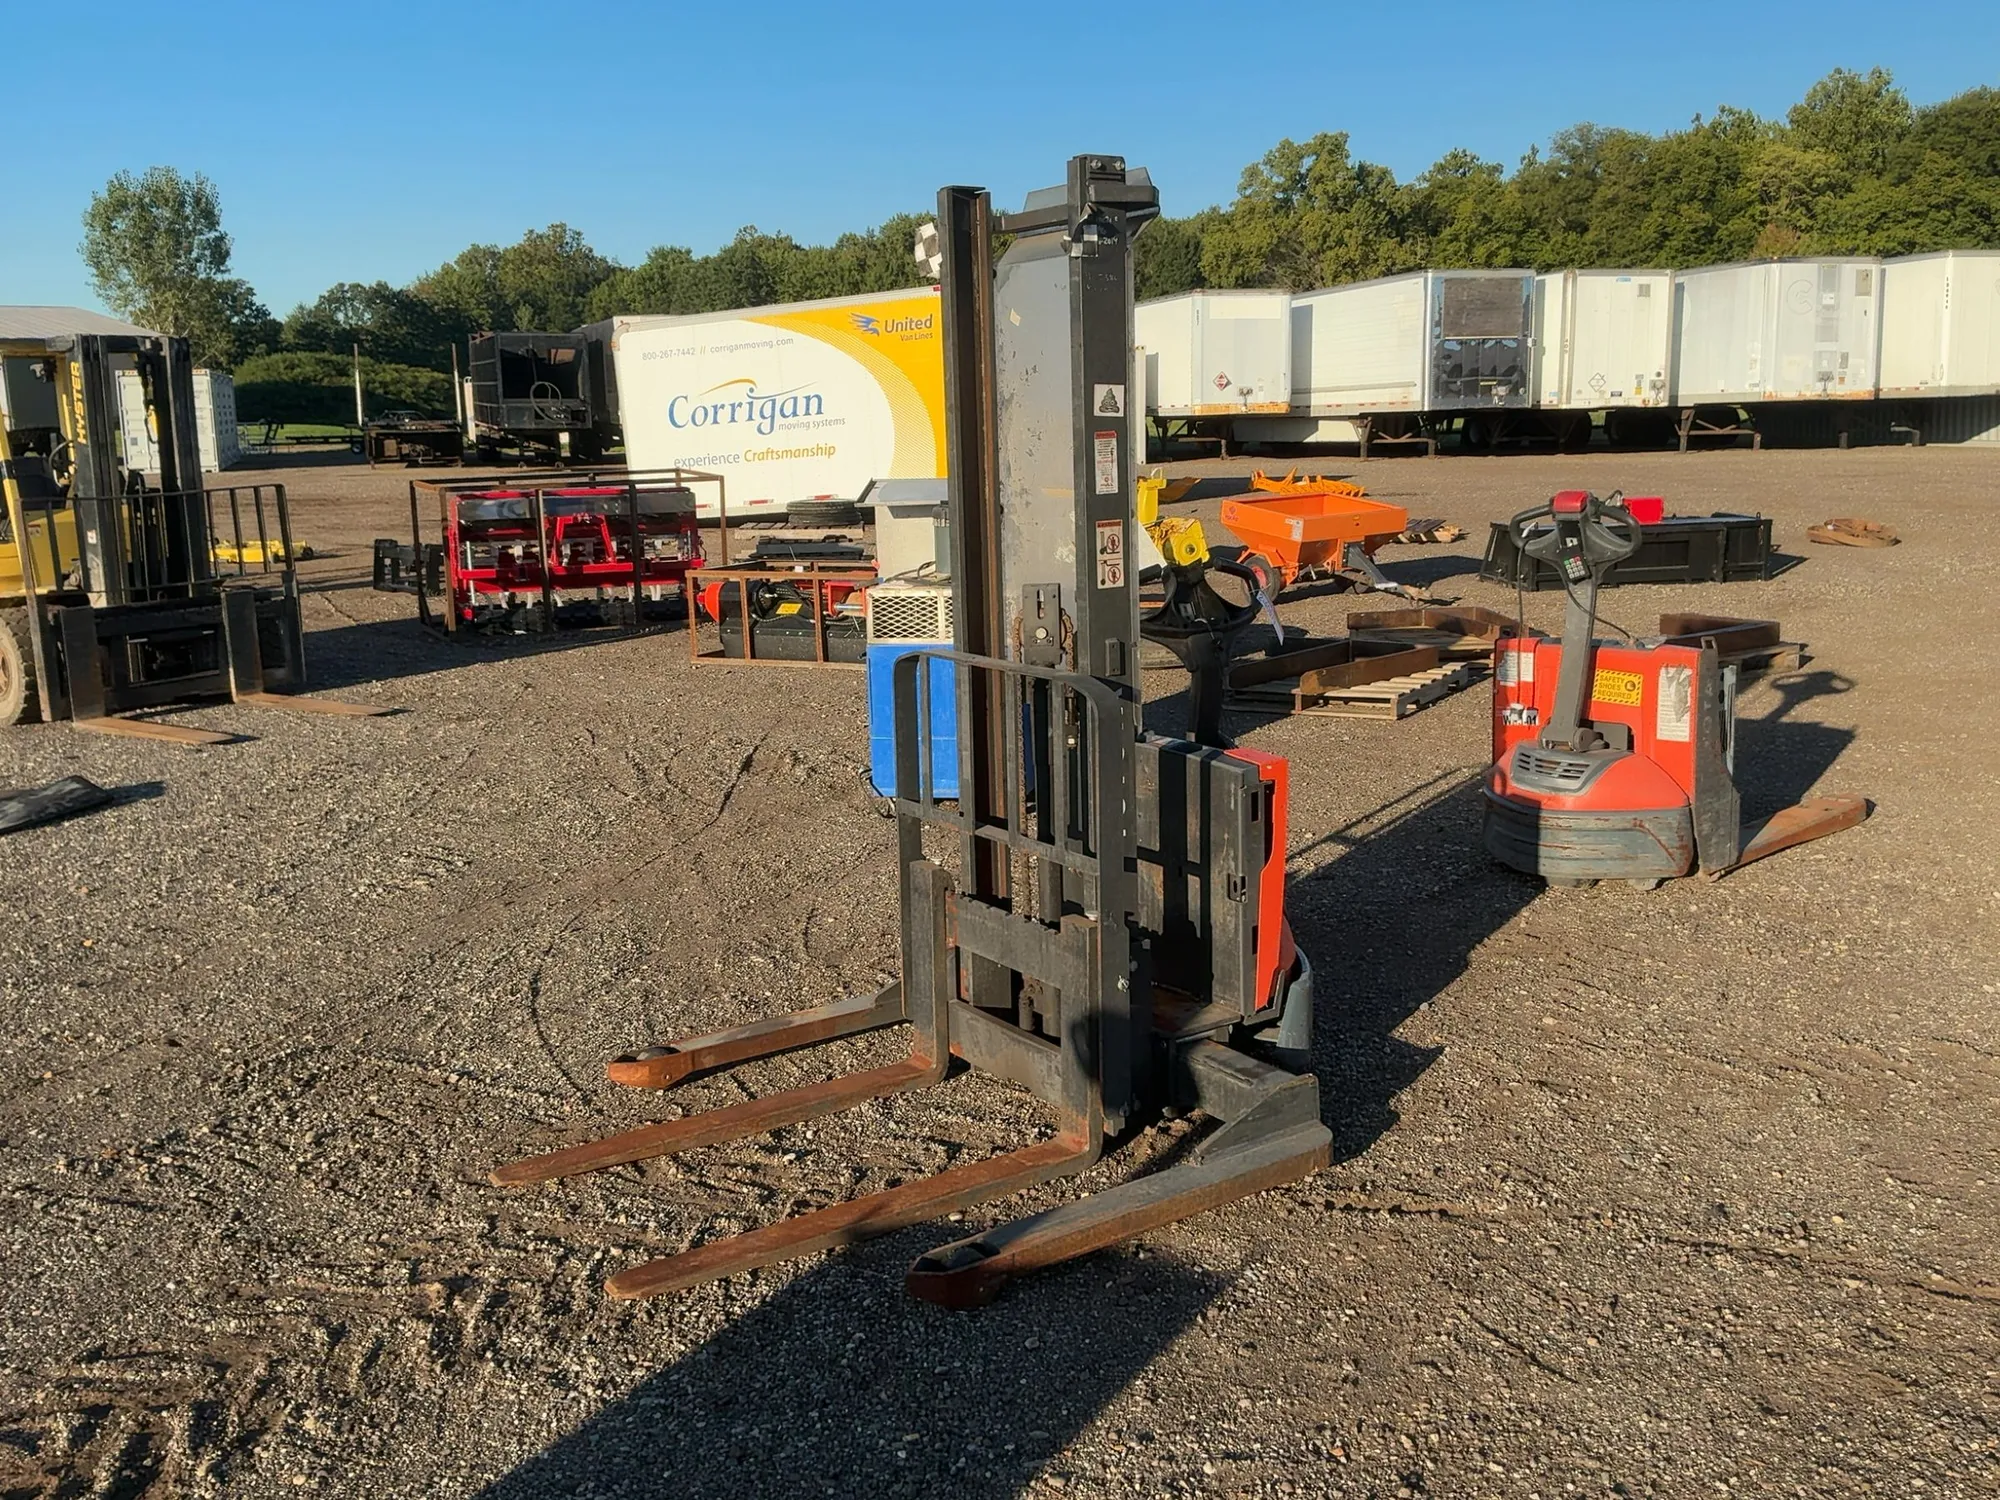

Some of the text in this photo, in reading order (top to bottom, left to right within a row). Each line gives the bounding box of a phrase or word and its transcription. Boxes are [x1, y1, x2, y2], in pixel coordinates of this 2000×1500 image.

[884, 313, 933, 333] United
[900, 332, 933, 341] Van Lines
[642, 347, 696, 361] 800-267-7442
[710, 337, 794, 353] corriganmoving.com
[71, 361, 87, 445] HYSTER
[668, 386, 824, 435] Corrigan
[778, 417, 846, 432] moving systems
[674, 443, 836, 469] experience Craftsmanship
[1598, 682, 1621, 691] SHOES
[1599, 674, 1625, 684] SAFETY
[1597, 688, 1632, 699] REQUIRED
